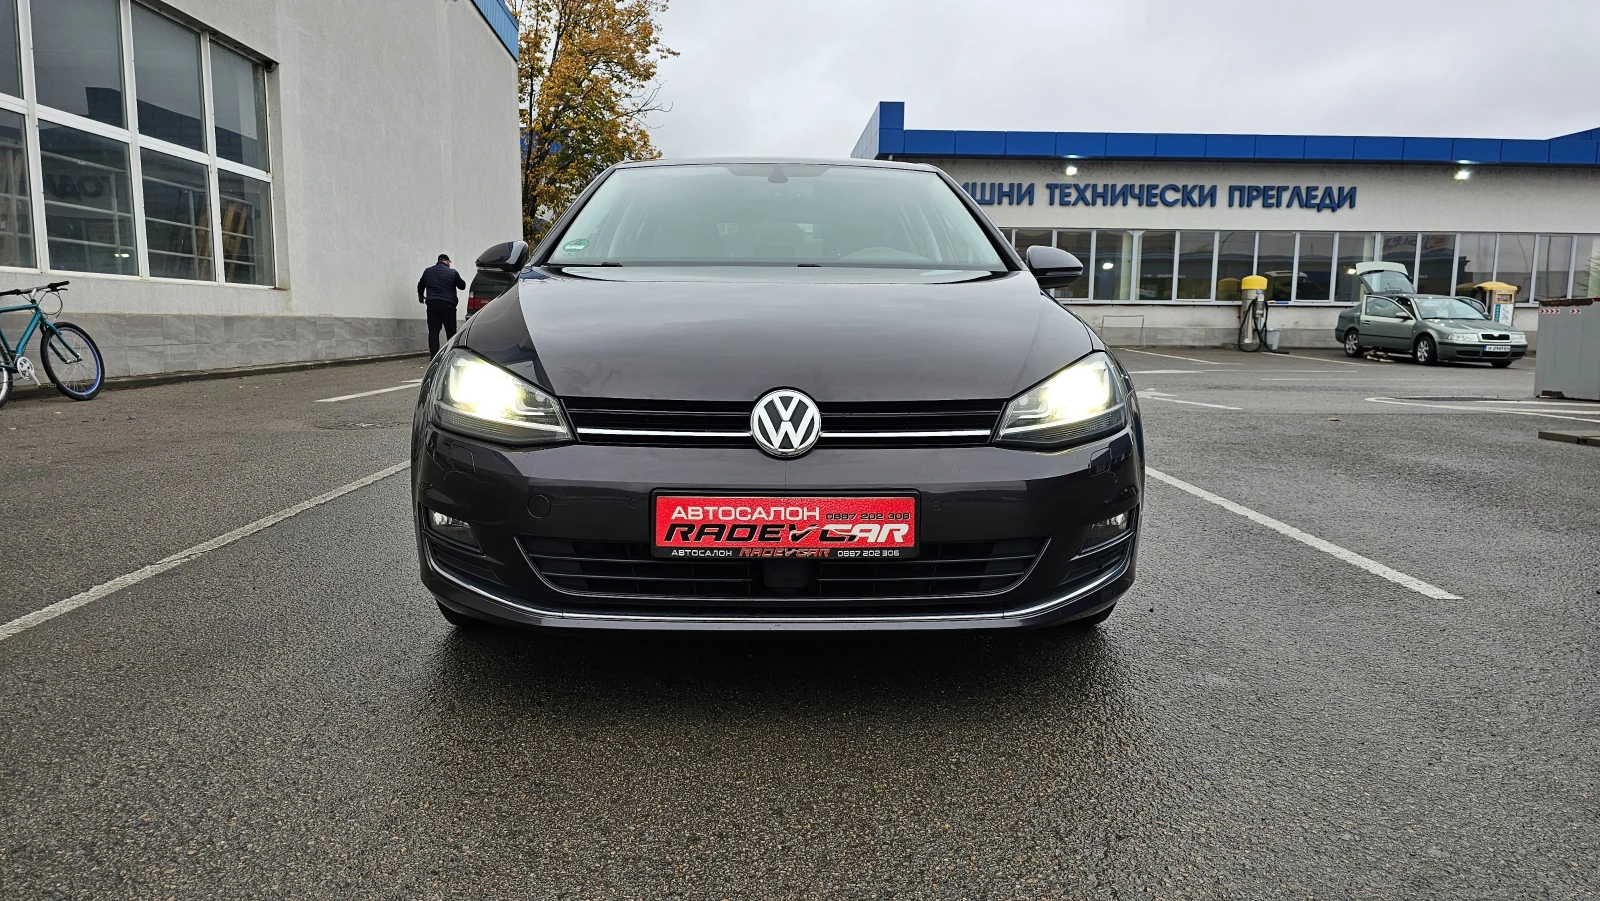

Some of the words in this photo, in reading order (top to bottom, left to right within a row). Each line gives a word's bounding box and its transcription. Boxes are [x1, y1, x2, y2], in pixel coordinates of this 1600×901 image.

[1046, 183, 1217, 207] ТЕХНИЧЕСКИ
[1228, 185, 1357, 212] ПРЕГЛЕДИ
[753, 390, 820, 455] VW
[670, 506, 820, 521] АВТОСАЛОН
[825, 513, 857, 521] 0887
[860, 513, 884, 521] 202
[887, 513, 911, 521] 306
[671, 549, 733, 557] АВТОСАЛОН
